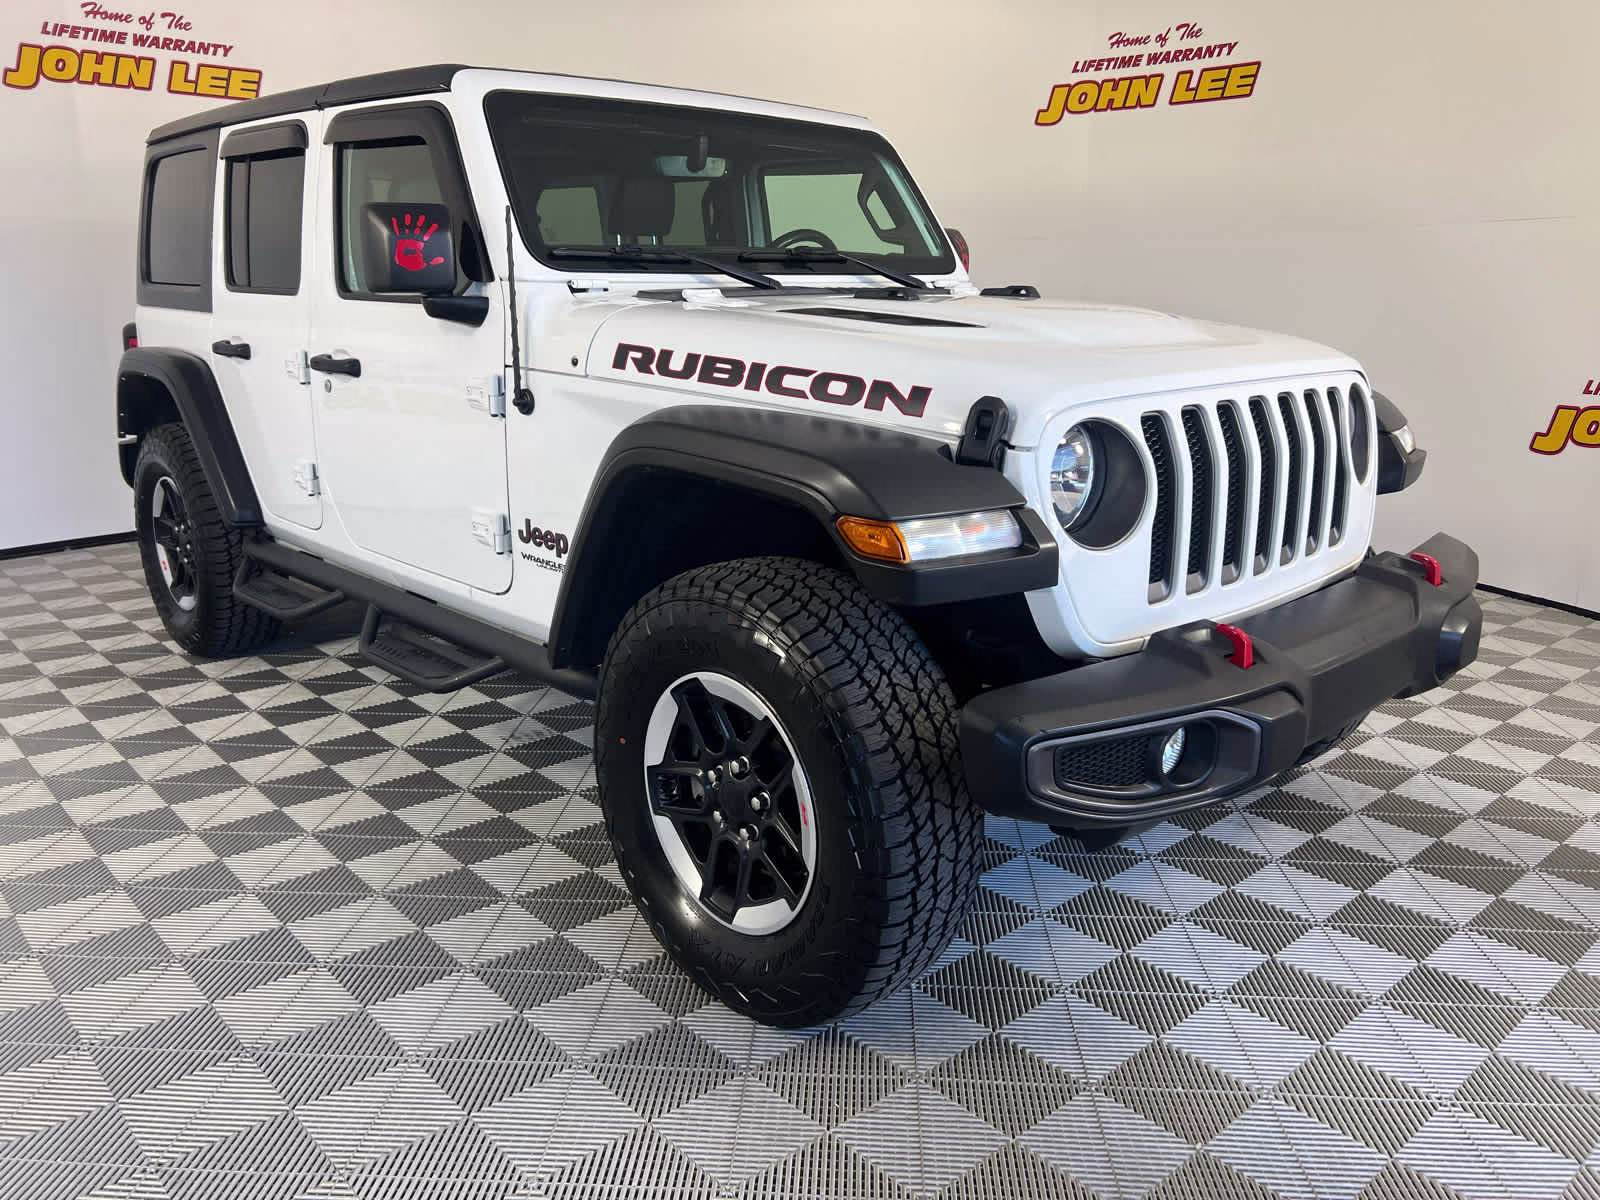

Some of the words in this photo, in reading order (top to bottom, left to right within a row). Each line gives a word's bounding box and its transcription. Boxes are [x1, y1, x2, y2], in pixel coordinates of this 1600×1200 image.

[80, 1, 134, 23] Home
[138, 12, 156, 31] of
[160, 12, 193, 31] The
[1108, 31, 1151, 49] Home
[1154, 27, 1171, 48] of
[1175, 22, 1203, 41] The
[40, 21, 128, 45] LIFETIME
[132, 33, 234, 57] WARRANTY
[1071, 53, 1144, 74] LIFETIME
[1145, 41, 1239, 66] WARRANTY
[3, 43, 156, 90] JOHN
[167, 60, 262, 100] LEE
[1035, 73, 1164, 126] JOHN
[1169, 61, 1261, 105] LEE
[611, 342, 933, 418] RUBICON
[517, 517, 569, 559] Jeep
